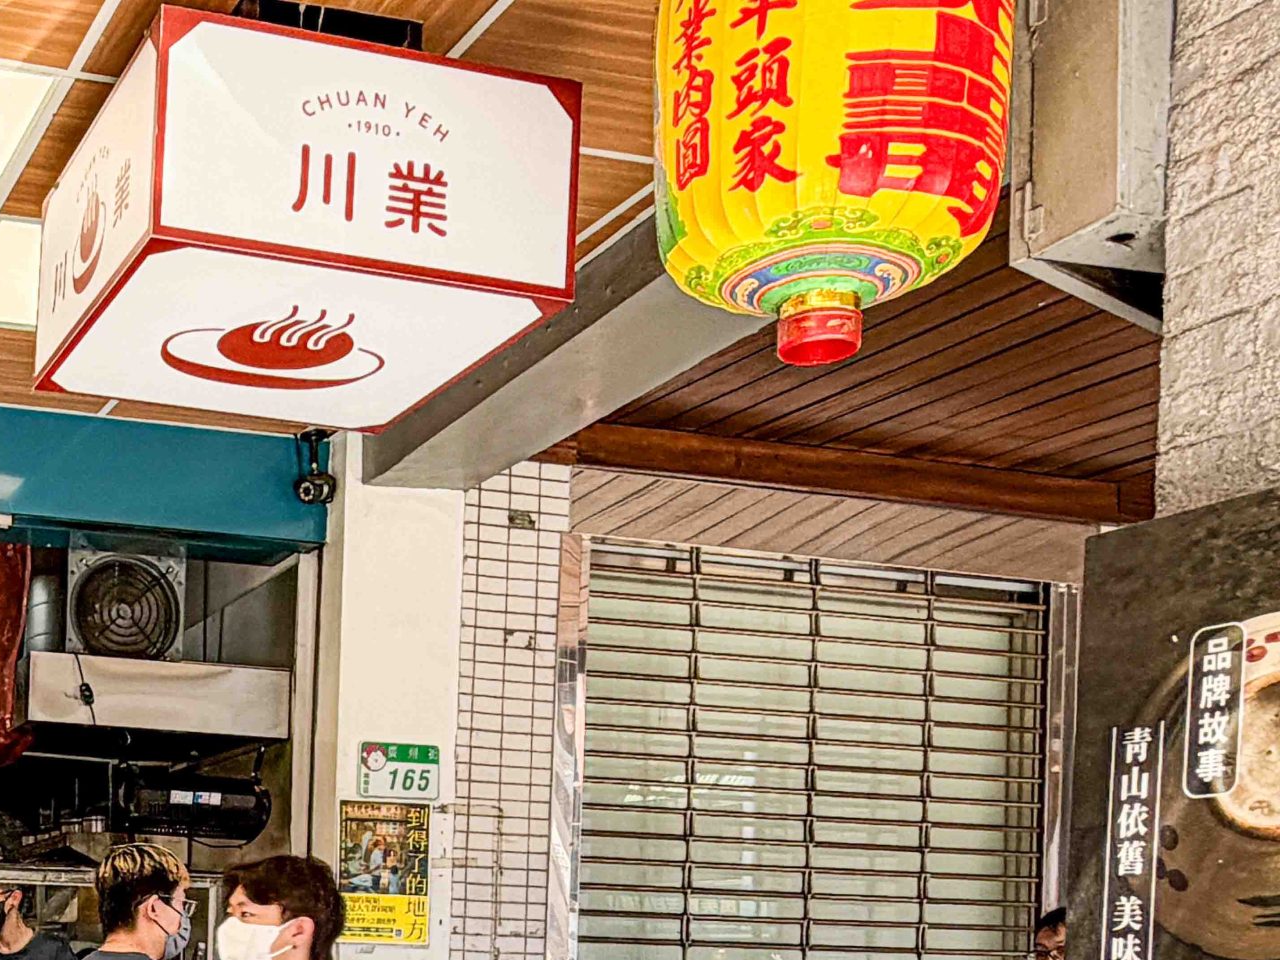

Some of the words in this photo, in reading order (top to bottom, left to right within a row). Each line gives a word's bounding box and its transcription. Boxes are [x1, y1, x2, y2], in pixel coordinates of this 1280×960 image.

[302, 90, 386, 117] CHUAN
[404, 101, 449, 142] YEH
[672, 0, 716, 191] 業肉圓
[292, 144, 448, 237] 川業
[1195, 636, 1233, 782] 品牌故事
[389, 768, 431, 792] 165
[1116, 727, 1153, 877] 青山依舊
[406, 807, 428, 941] 到得了的地方
